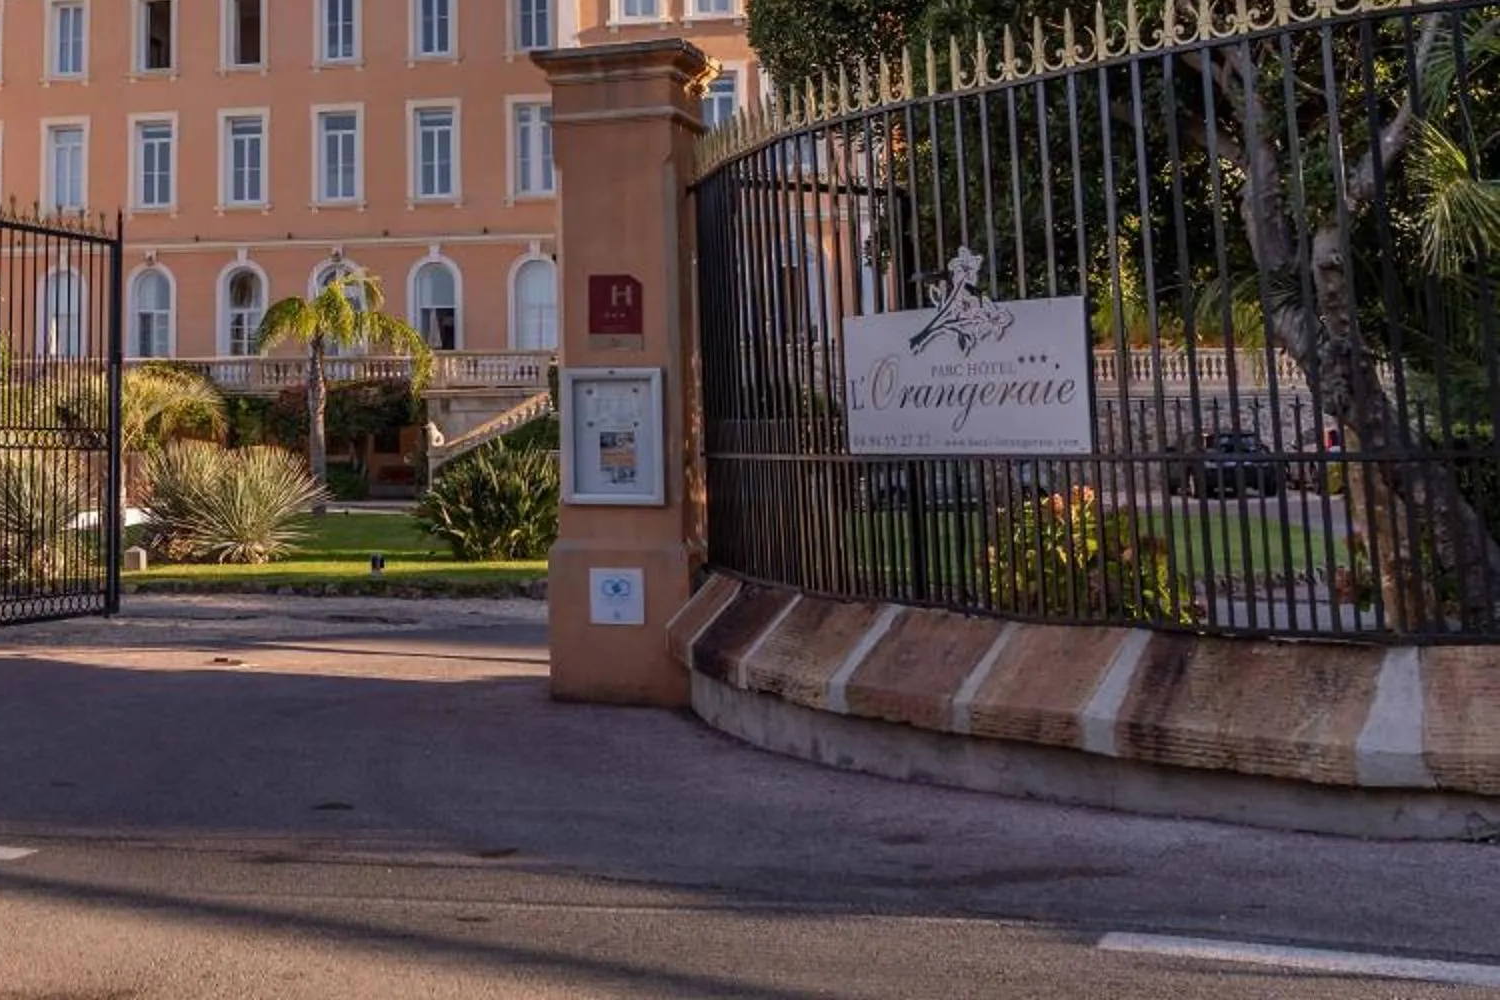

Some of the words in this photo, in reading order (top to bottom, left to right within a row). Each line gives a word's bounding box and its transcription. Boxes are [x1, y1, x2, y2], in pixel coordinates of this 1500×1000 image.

[611, 285, 632, 306] H
[931, 363, 963, 377] PARC
[850, 354, 1076, 432] L'Orangeraie
